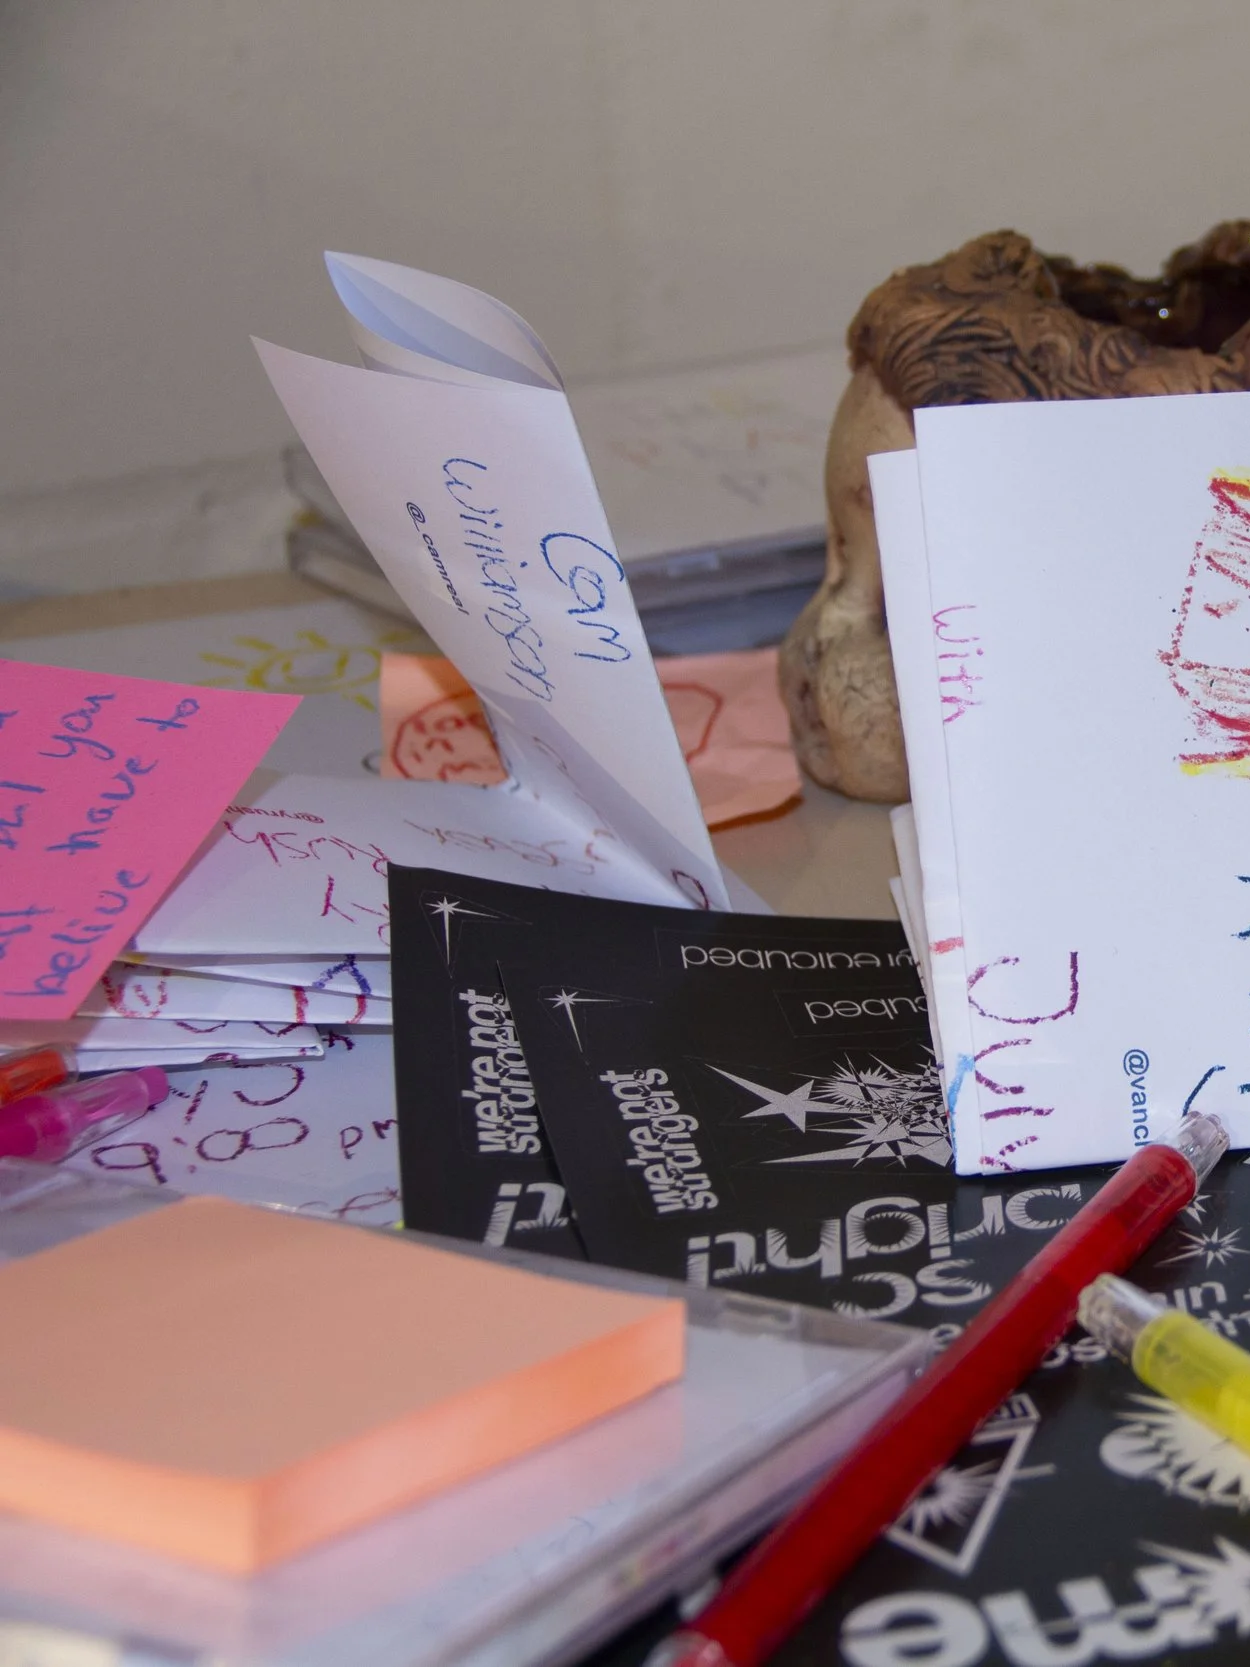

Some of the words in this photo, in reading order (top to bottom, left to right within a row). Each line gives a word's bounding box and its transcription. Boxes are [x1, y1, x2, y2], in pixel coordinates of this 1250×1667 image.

[540, 531, 631, 663] Cam
[39, 692, 117, 760] you
[48, 755, 156, 857] have
[136, 696, 201, 733] to
[804, 996, 927, 1024] cubed
